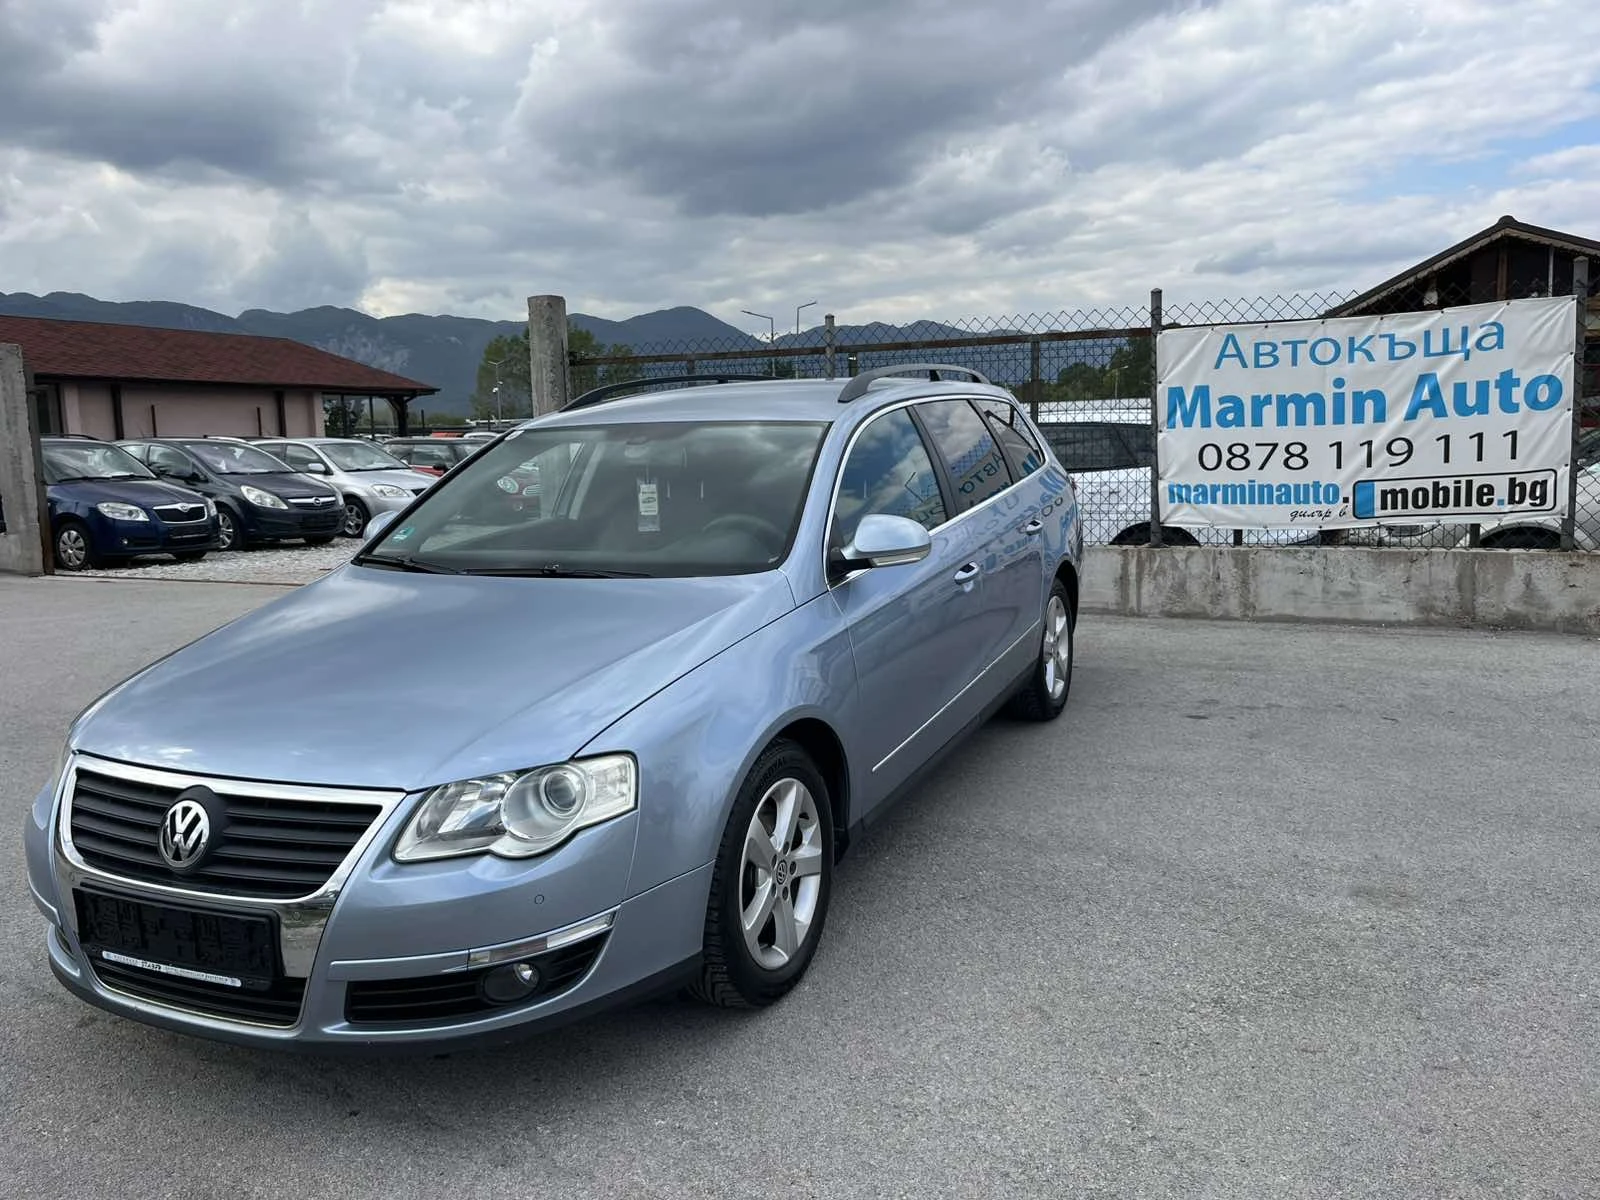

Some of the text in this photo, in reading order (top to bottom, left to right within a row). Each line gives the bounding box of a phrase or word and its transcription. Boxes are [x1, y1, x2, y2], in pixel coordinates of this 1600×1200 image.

[1213, 320, 1505, 370] Автокъща
[1166, 368, 1563, 430] Marmin Auto
[1198, 430, 1518, 471] 0878 119 111
[1380, 476, 1548, 511] mobile.bg
